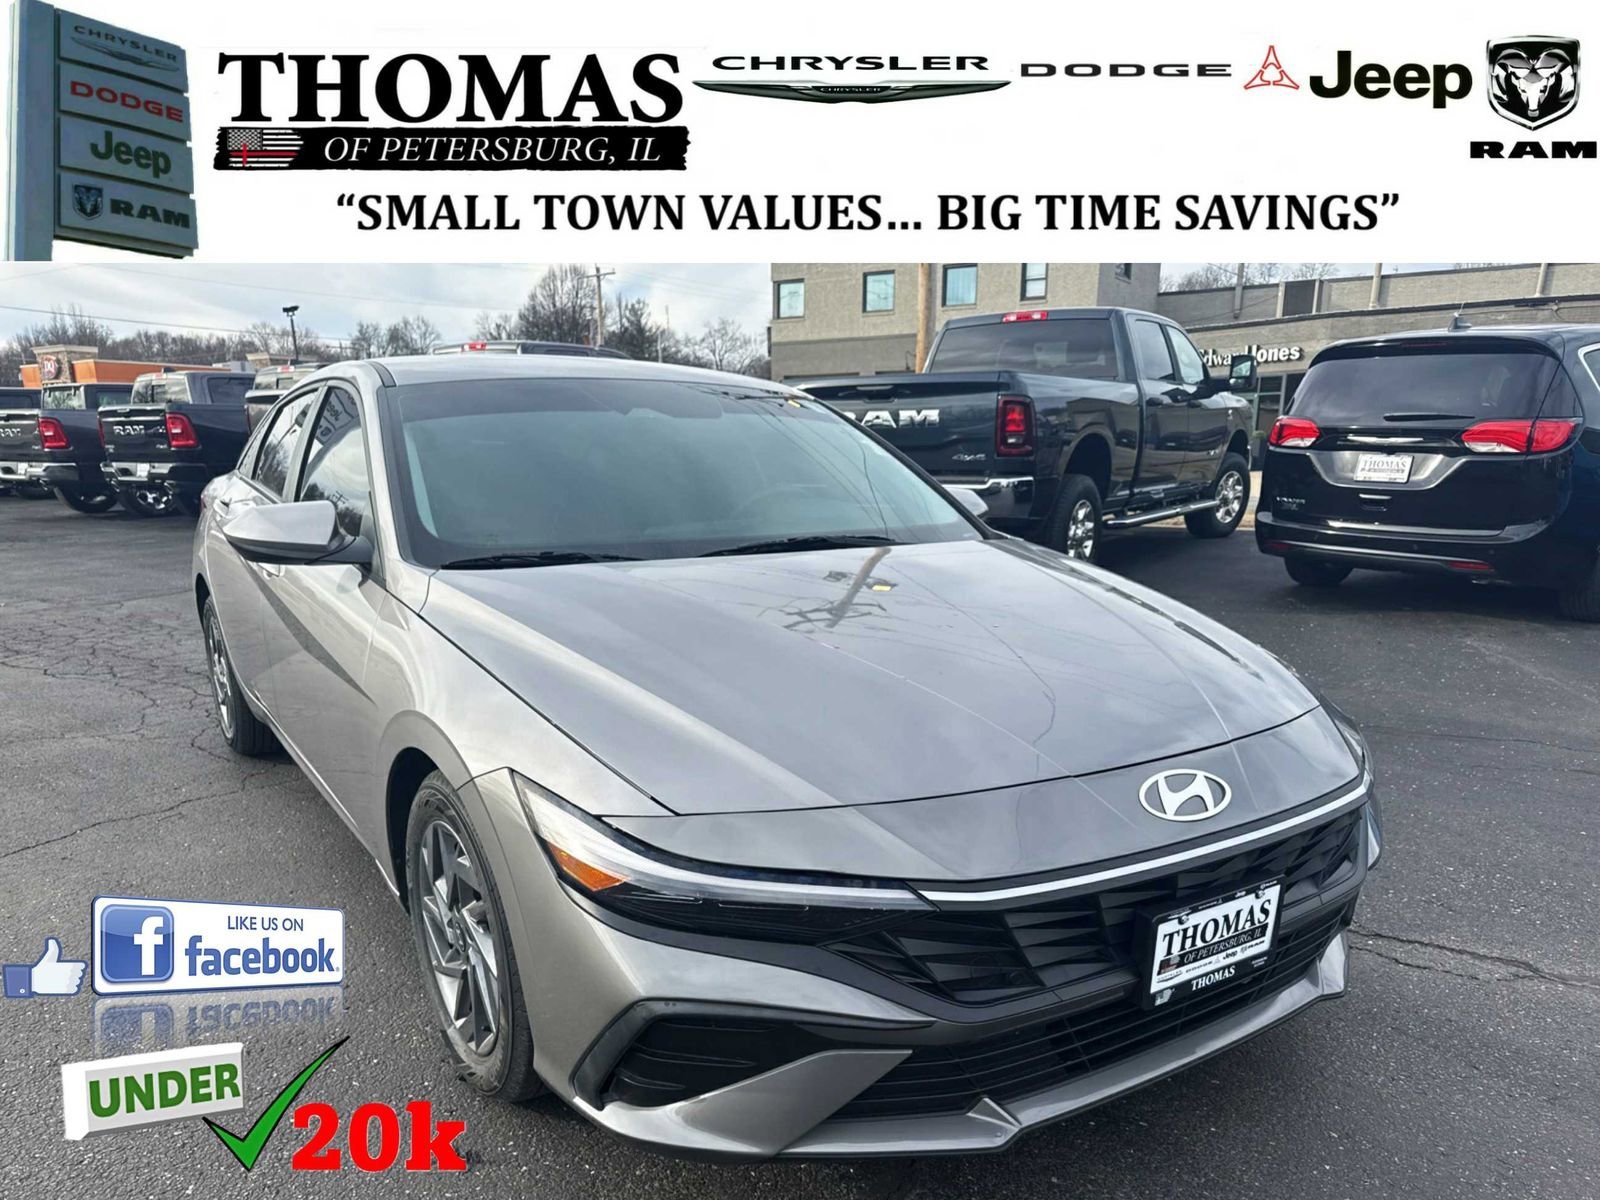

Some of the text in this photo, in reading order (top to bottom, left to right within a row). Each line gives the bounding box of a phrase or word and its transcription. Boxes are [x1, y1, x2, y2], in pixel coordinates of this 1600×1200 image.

[1251, 343, 1300, 366] Jones
[113, 425, 145, 435] RAM
[1162, 899, 1272, 958] THOMAS
[1184, 952, 1197, 964] OF
[1222, 950, 1238, 960] Jeep
[1191, 965, 1236, 991] THOMAS
